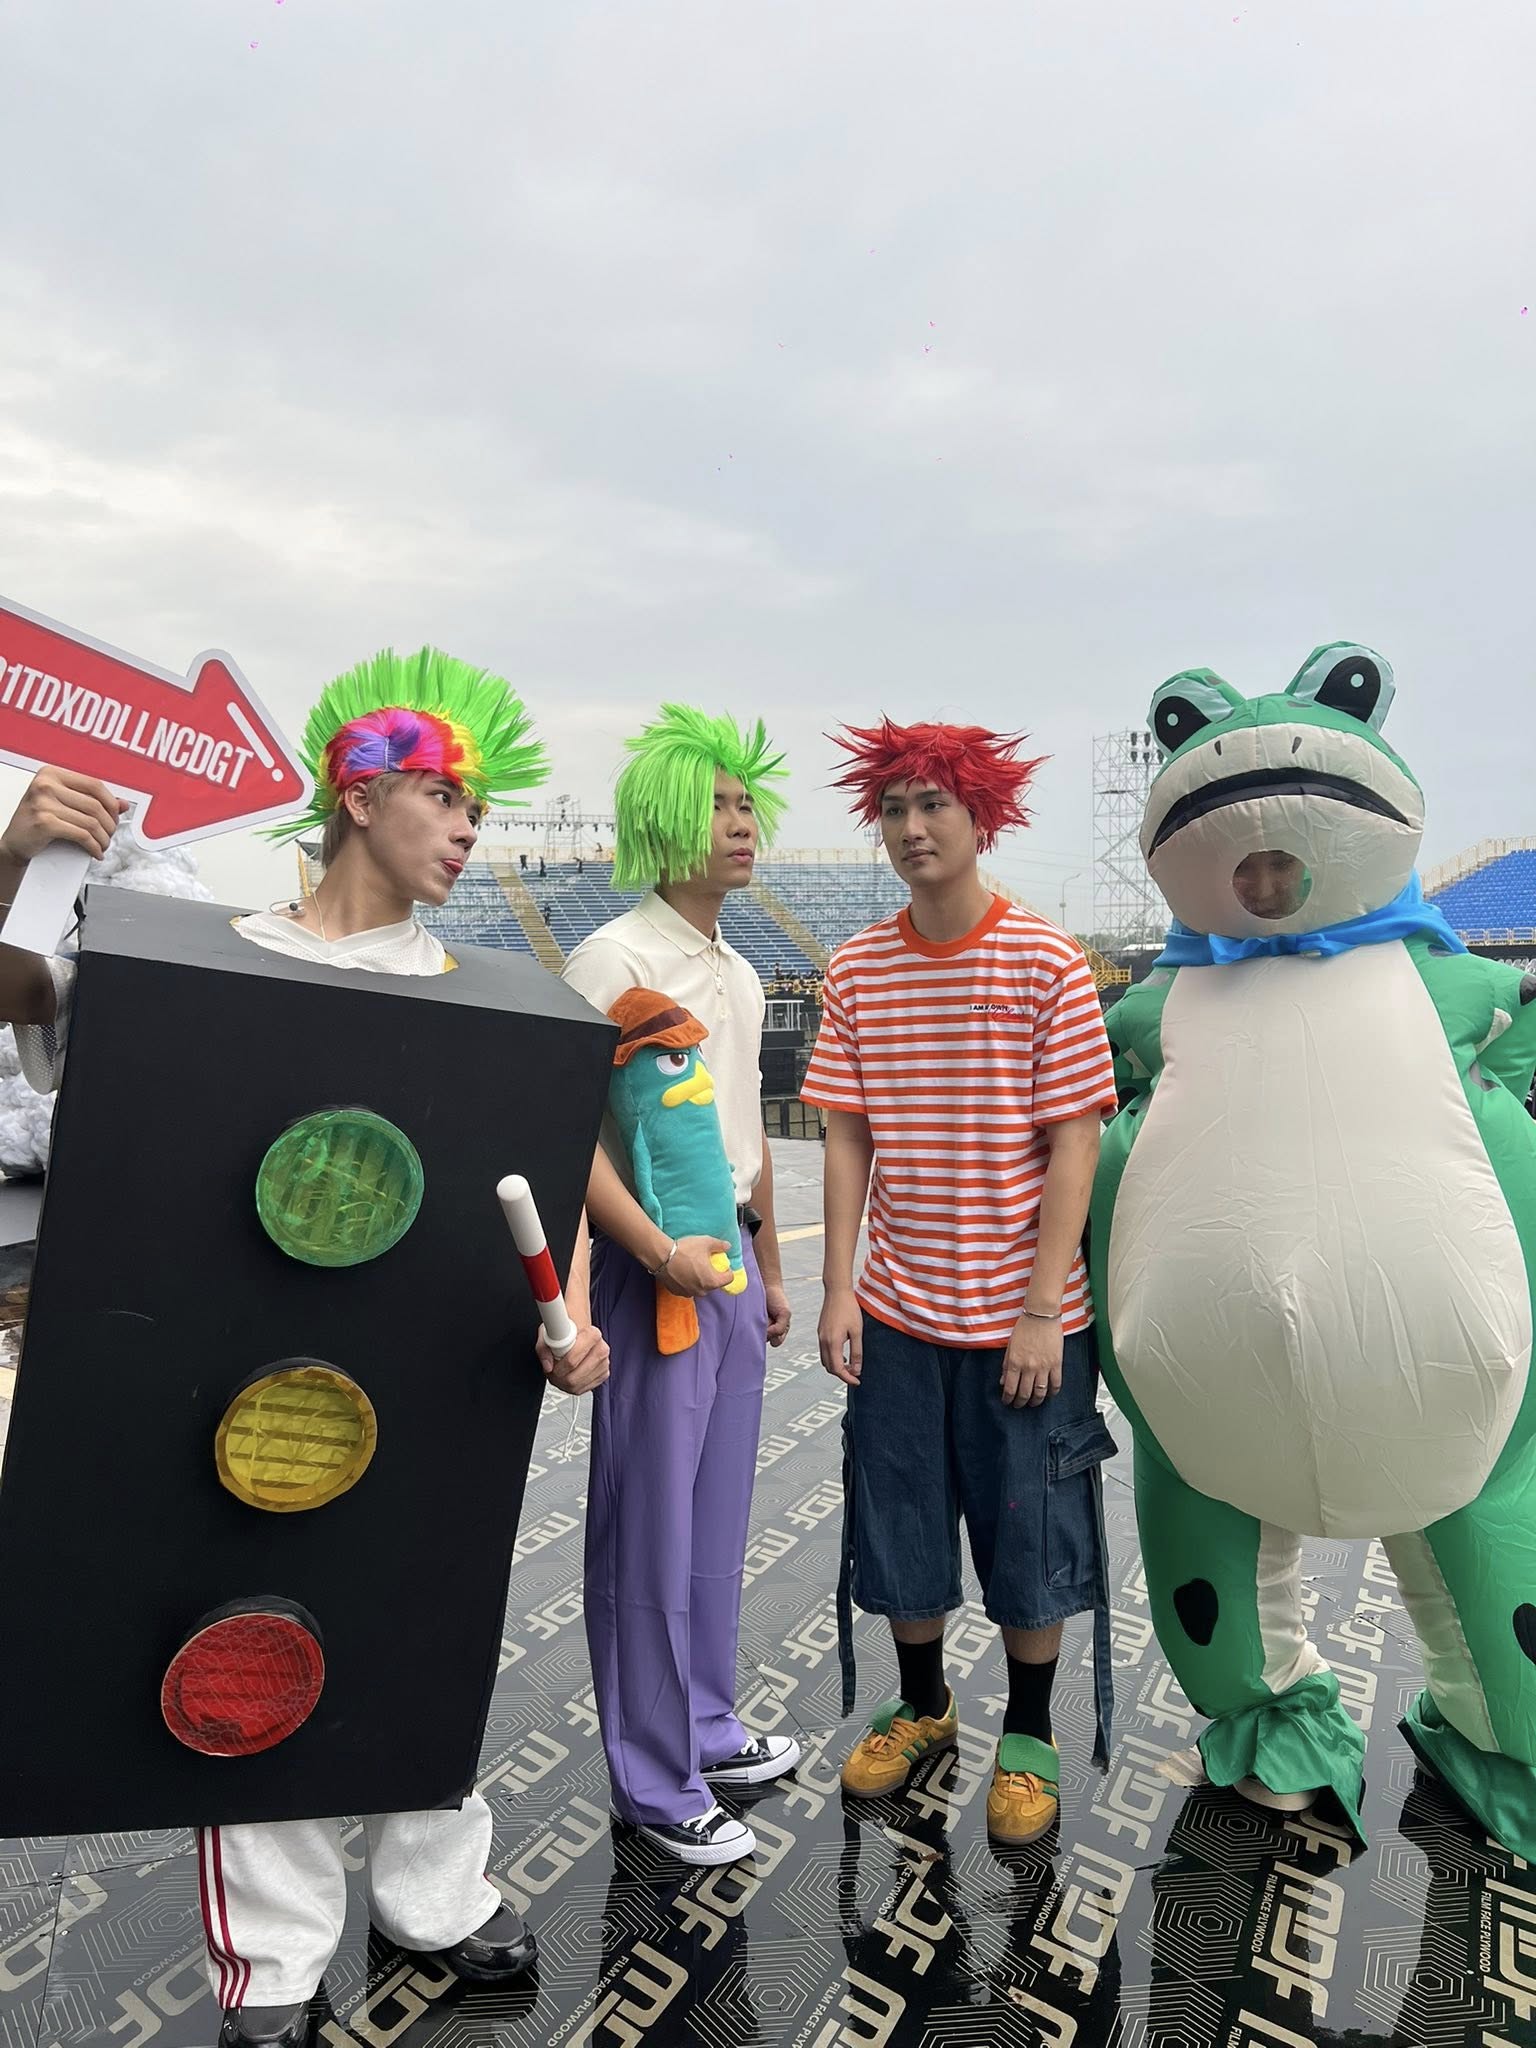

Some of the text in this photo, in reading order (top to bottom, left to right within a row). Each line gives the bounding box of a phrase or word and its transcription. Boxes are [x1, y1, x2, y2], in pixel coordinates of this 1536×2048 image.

[763, 1368, 799, 1397] MD
[755, 1435, 799, 1476] MD
[172, 1838, 194, 1855] ACE
[492, 1804, 566, 1872] FILM FACE PLYWOOD
[678, 1864, 707, 1894] WOOD
[876, 1875, 906, 1916] PLYWOOD
[1032, 1853, 1074, 1932] FILM FACE PLYWOOD
[32, 1905, 56, 1925] ACE
[1250, 1873, 1278, 1953] FILM FACE PLYWOOD
[1478, 1891, 1492, 1972] FILM FACE PLYWOOD
[132, 1942, 189, 1987] PLYWOOD
[332, 1970, 384, 2019] PLYWOOD
[545, 1953, 629, 2048] FILM FACE PLYWOOD
[819, 1979, 841, 2005] FILM
[804, 2002, 827, 2029] FACE
